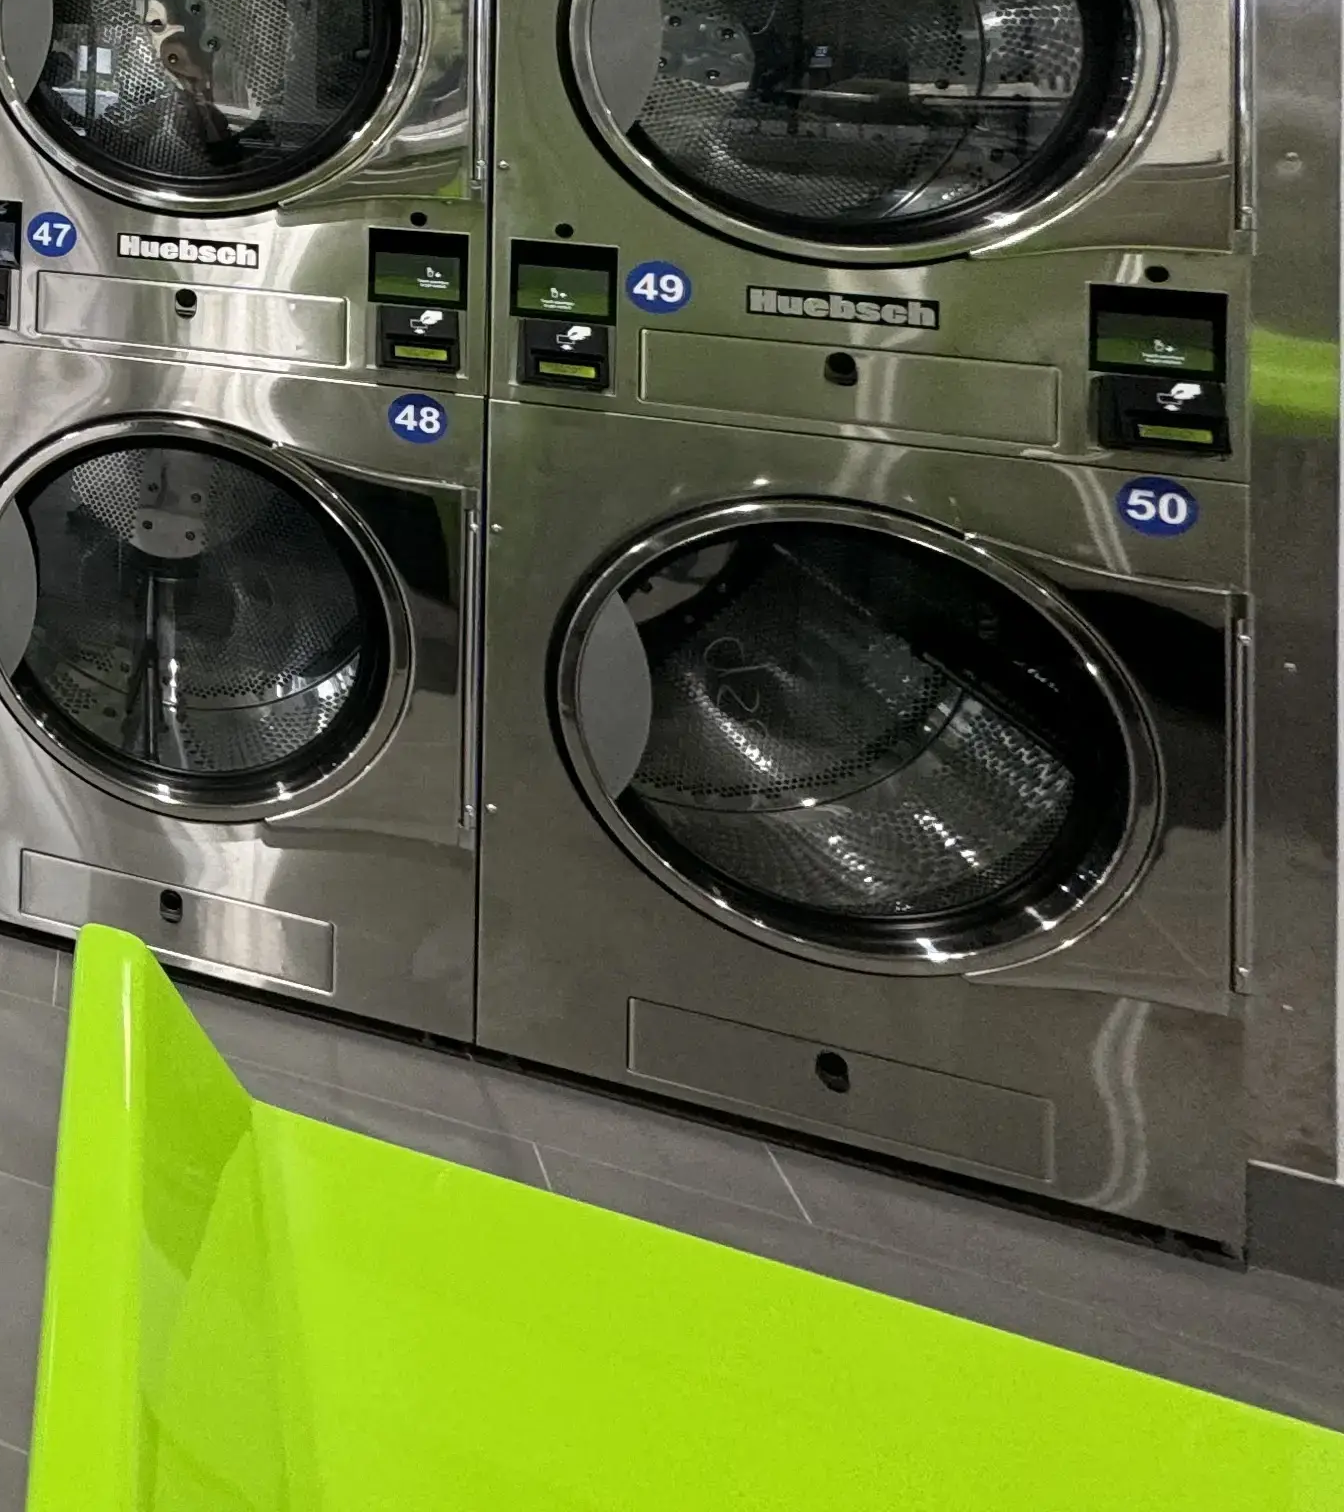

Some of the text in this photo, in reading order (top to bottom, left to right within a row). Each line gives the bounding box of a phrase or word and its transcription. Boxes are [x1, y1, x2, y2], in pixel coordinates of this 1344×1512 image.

[32, 222, 72, 247] 47
[120, 234, 258, 267] Huebsch
[632, 272, 684, 303] 49
[749, 288, 938, 328] Huebsch
[394, 404, 441, 434] 48
[1125, 489, 1188, 528] 50
